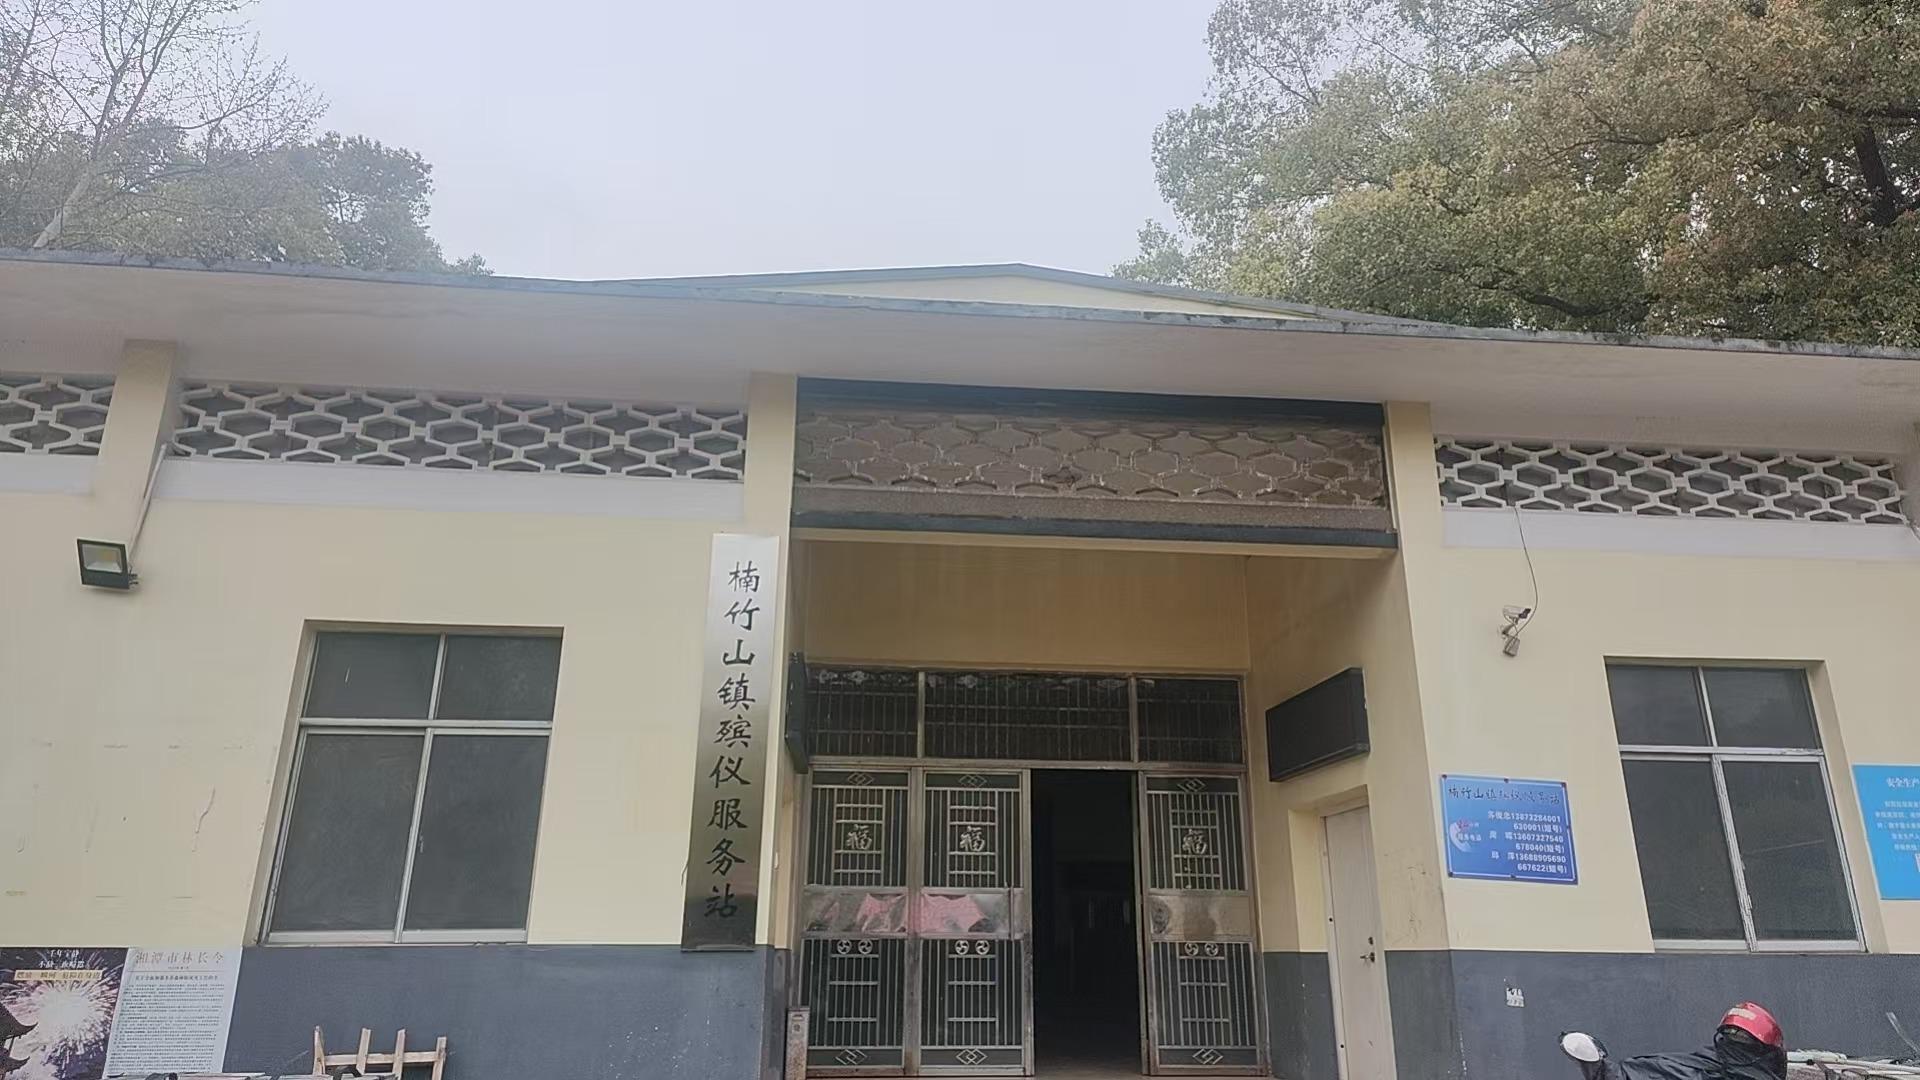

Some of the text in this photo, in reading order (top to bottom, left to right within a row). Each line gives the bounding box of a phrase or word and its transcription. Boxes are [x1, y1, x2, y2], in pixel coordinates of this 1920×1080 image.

[704, 560, 761, 919] 楠竹山镇殡仪服务站
[845, 824, 872, 851] 福
[960, 825, 985, 853] 福
[1182, 829, 1208, 854] 福
[135, 951, 224, 964] 湘潭市林长令
